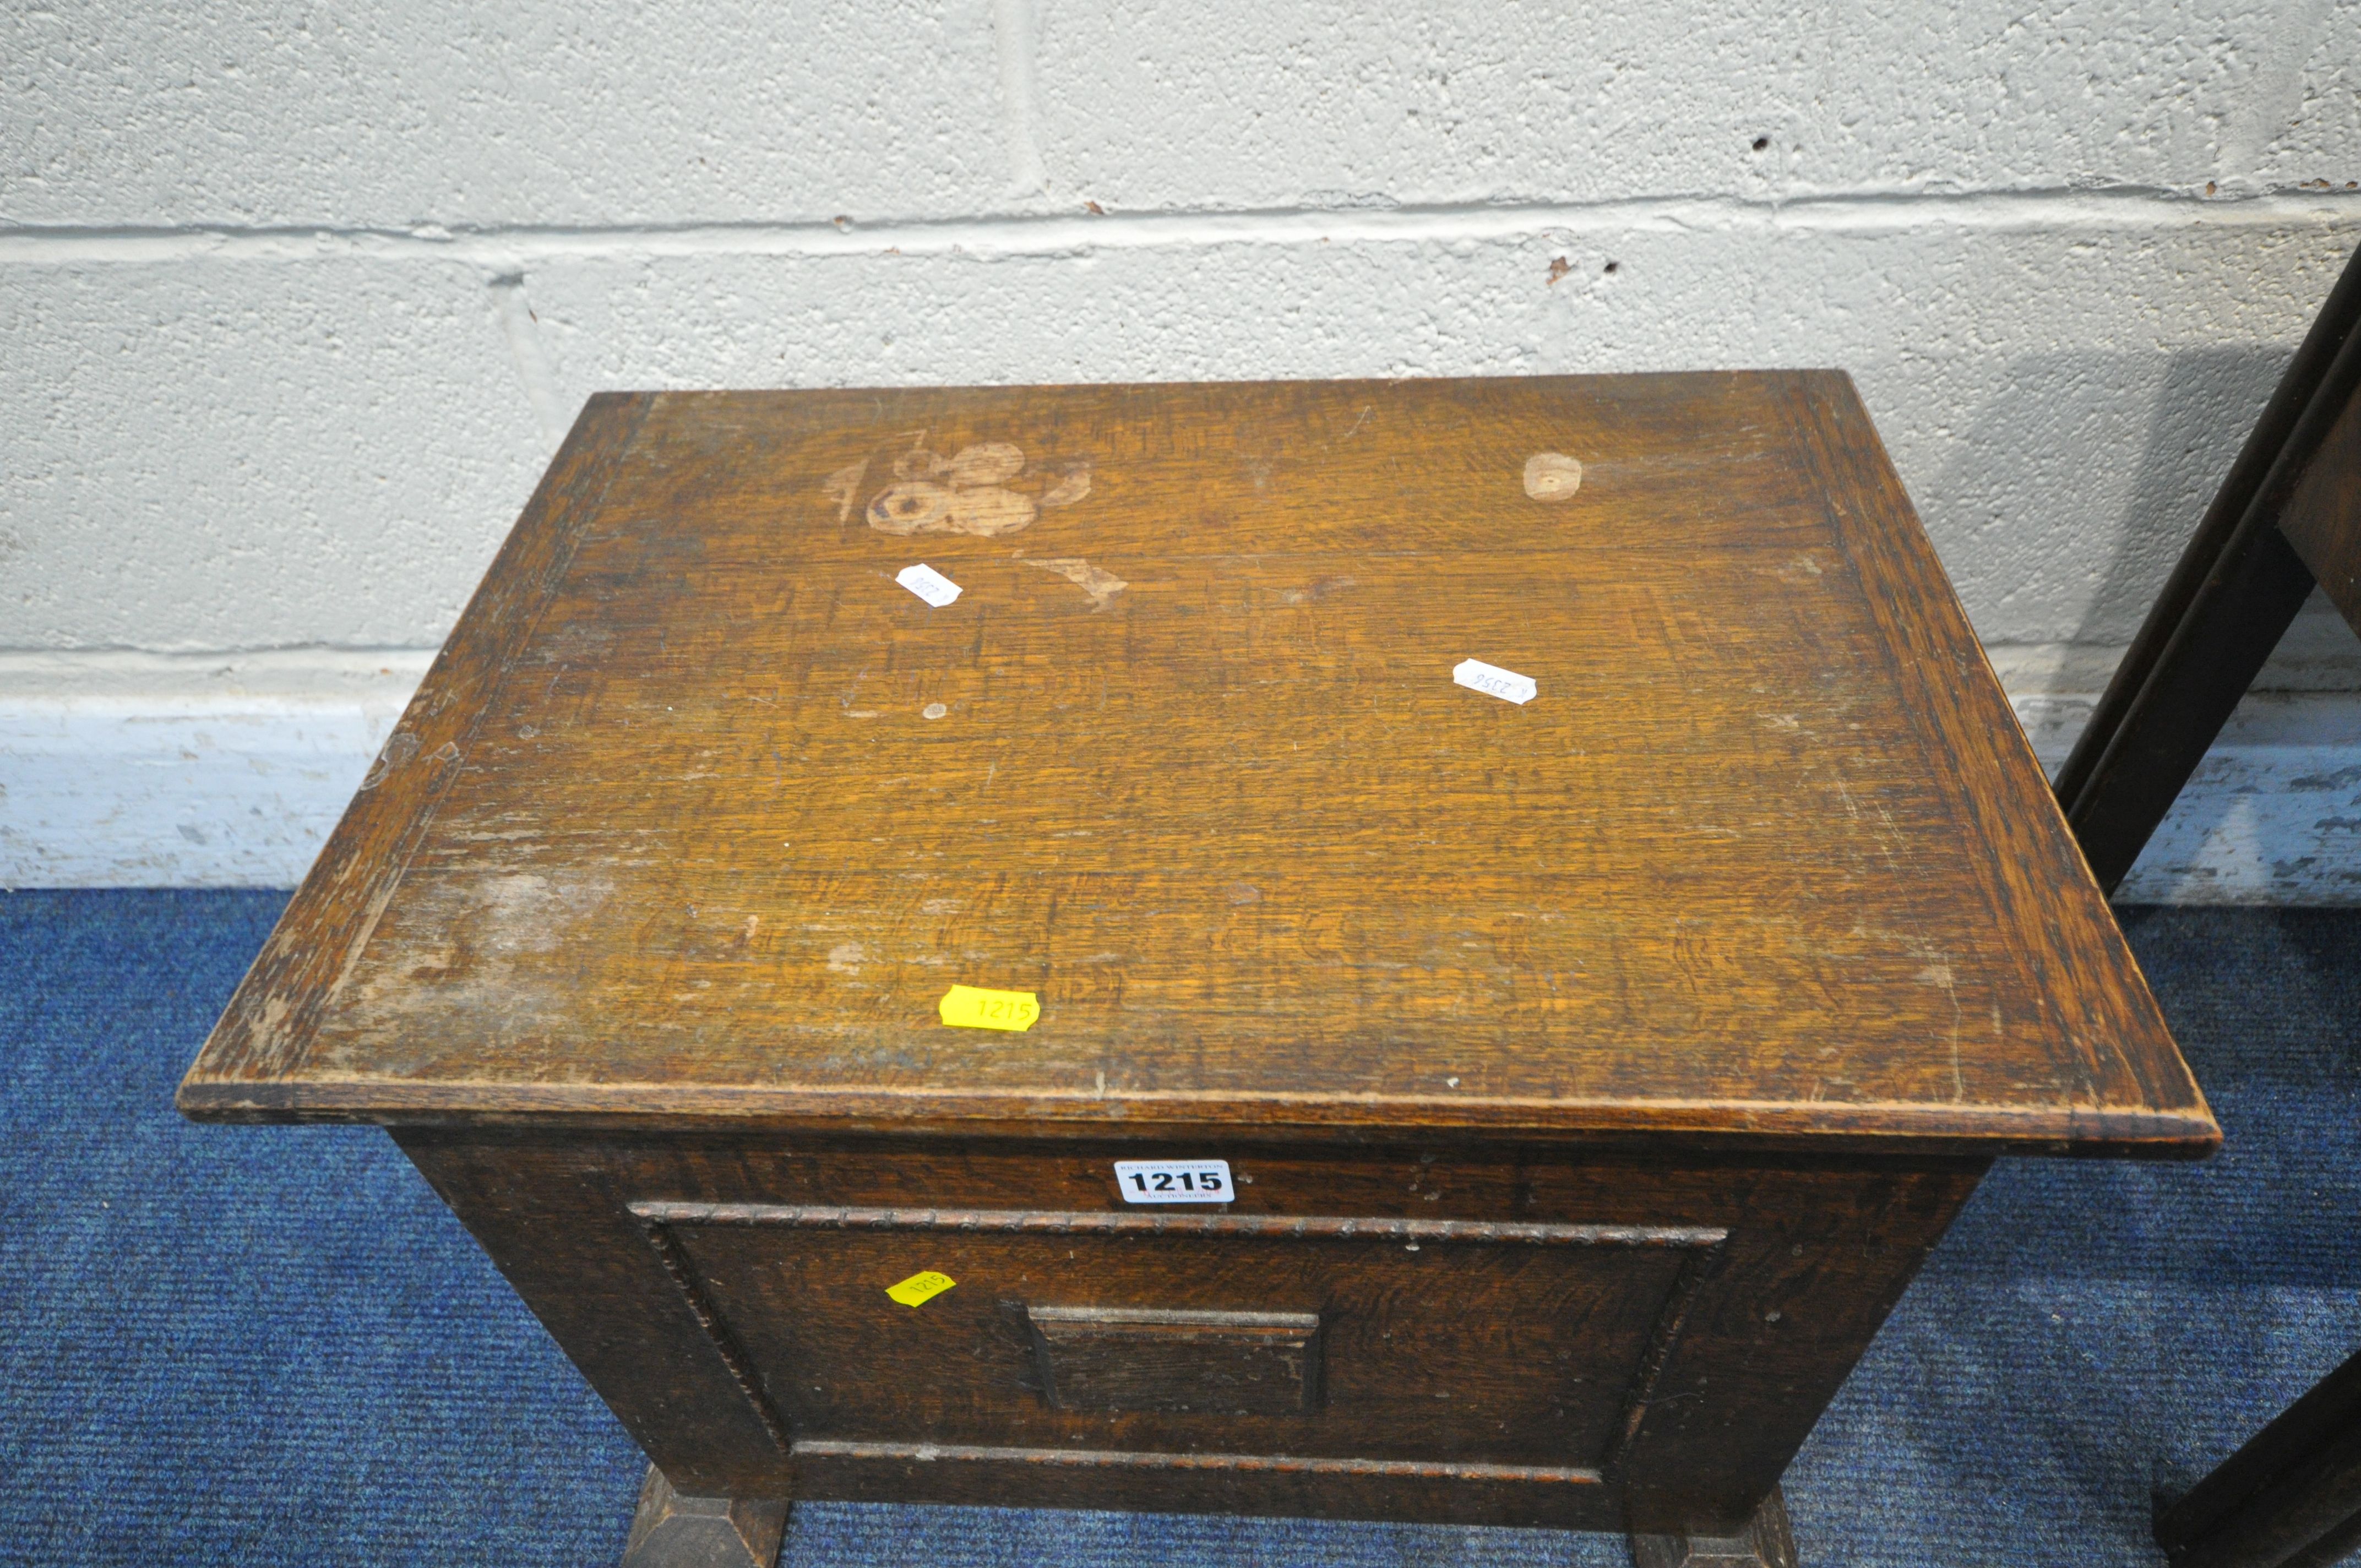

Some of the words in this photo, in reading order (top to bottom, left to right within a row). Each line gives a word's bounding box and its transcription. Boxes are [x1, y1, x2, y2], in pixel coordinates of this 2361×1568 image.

[1473, 674, 1511, 694] 2356
[978, 1000, 1032, 1020] 1215
[1128, 1172, 1222, 1191] 1215
[909, 1275, 945, 1293] 1215
